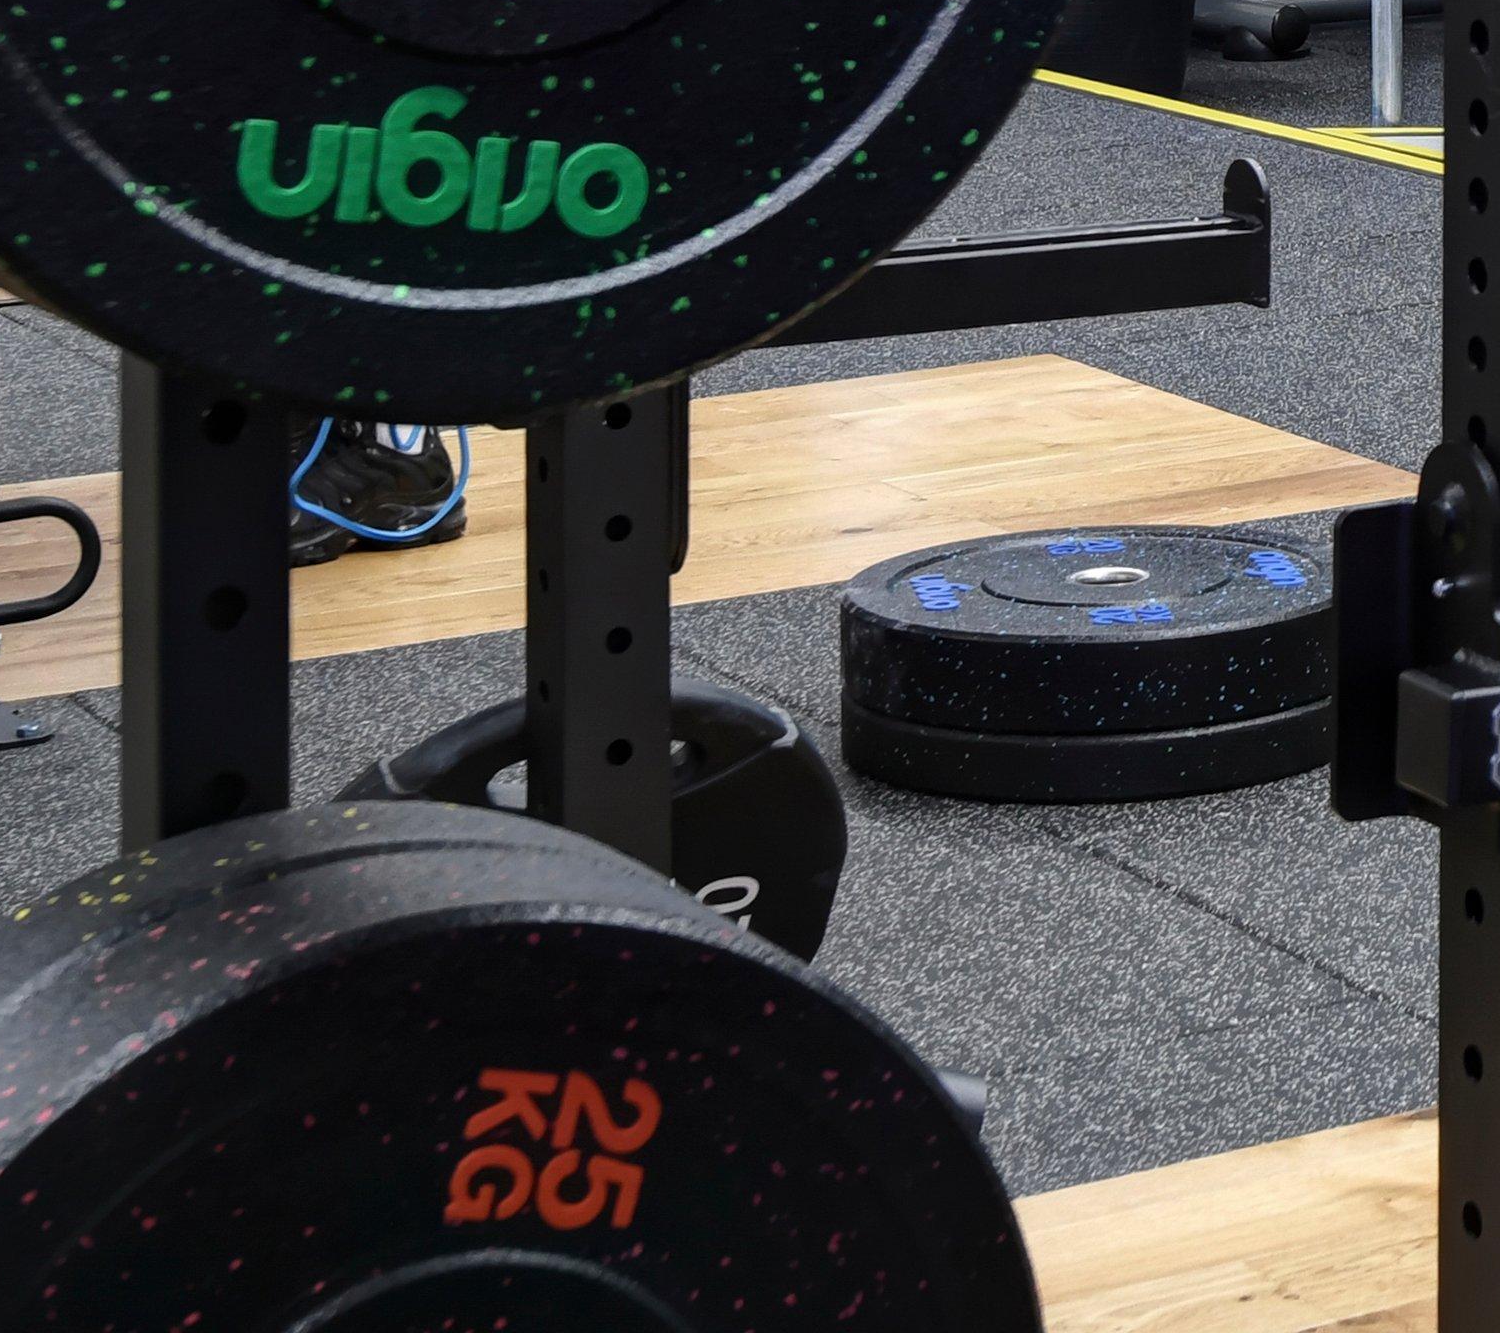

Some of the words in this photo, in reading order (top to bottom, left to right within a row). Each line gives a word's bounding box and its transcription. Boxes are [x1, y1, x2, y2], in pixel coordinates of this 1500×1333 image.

[235, 86, 649, 238] origin
[443, 1069, 554, 1225] KG
[530, 1074, 661, 1231] 25
